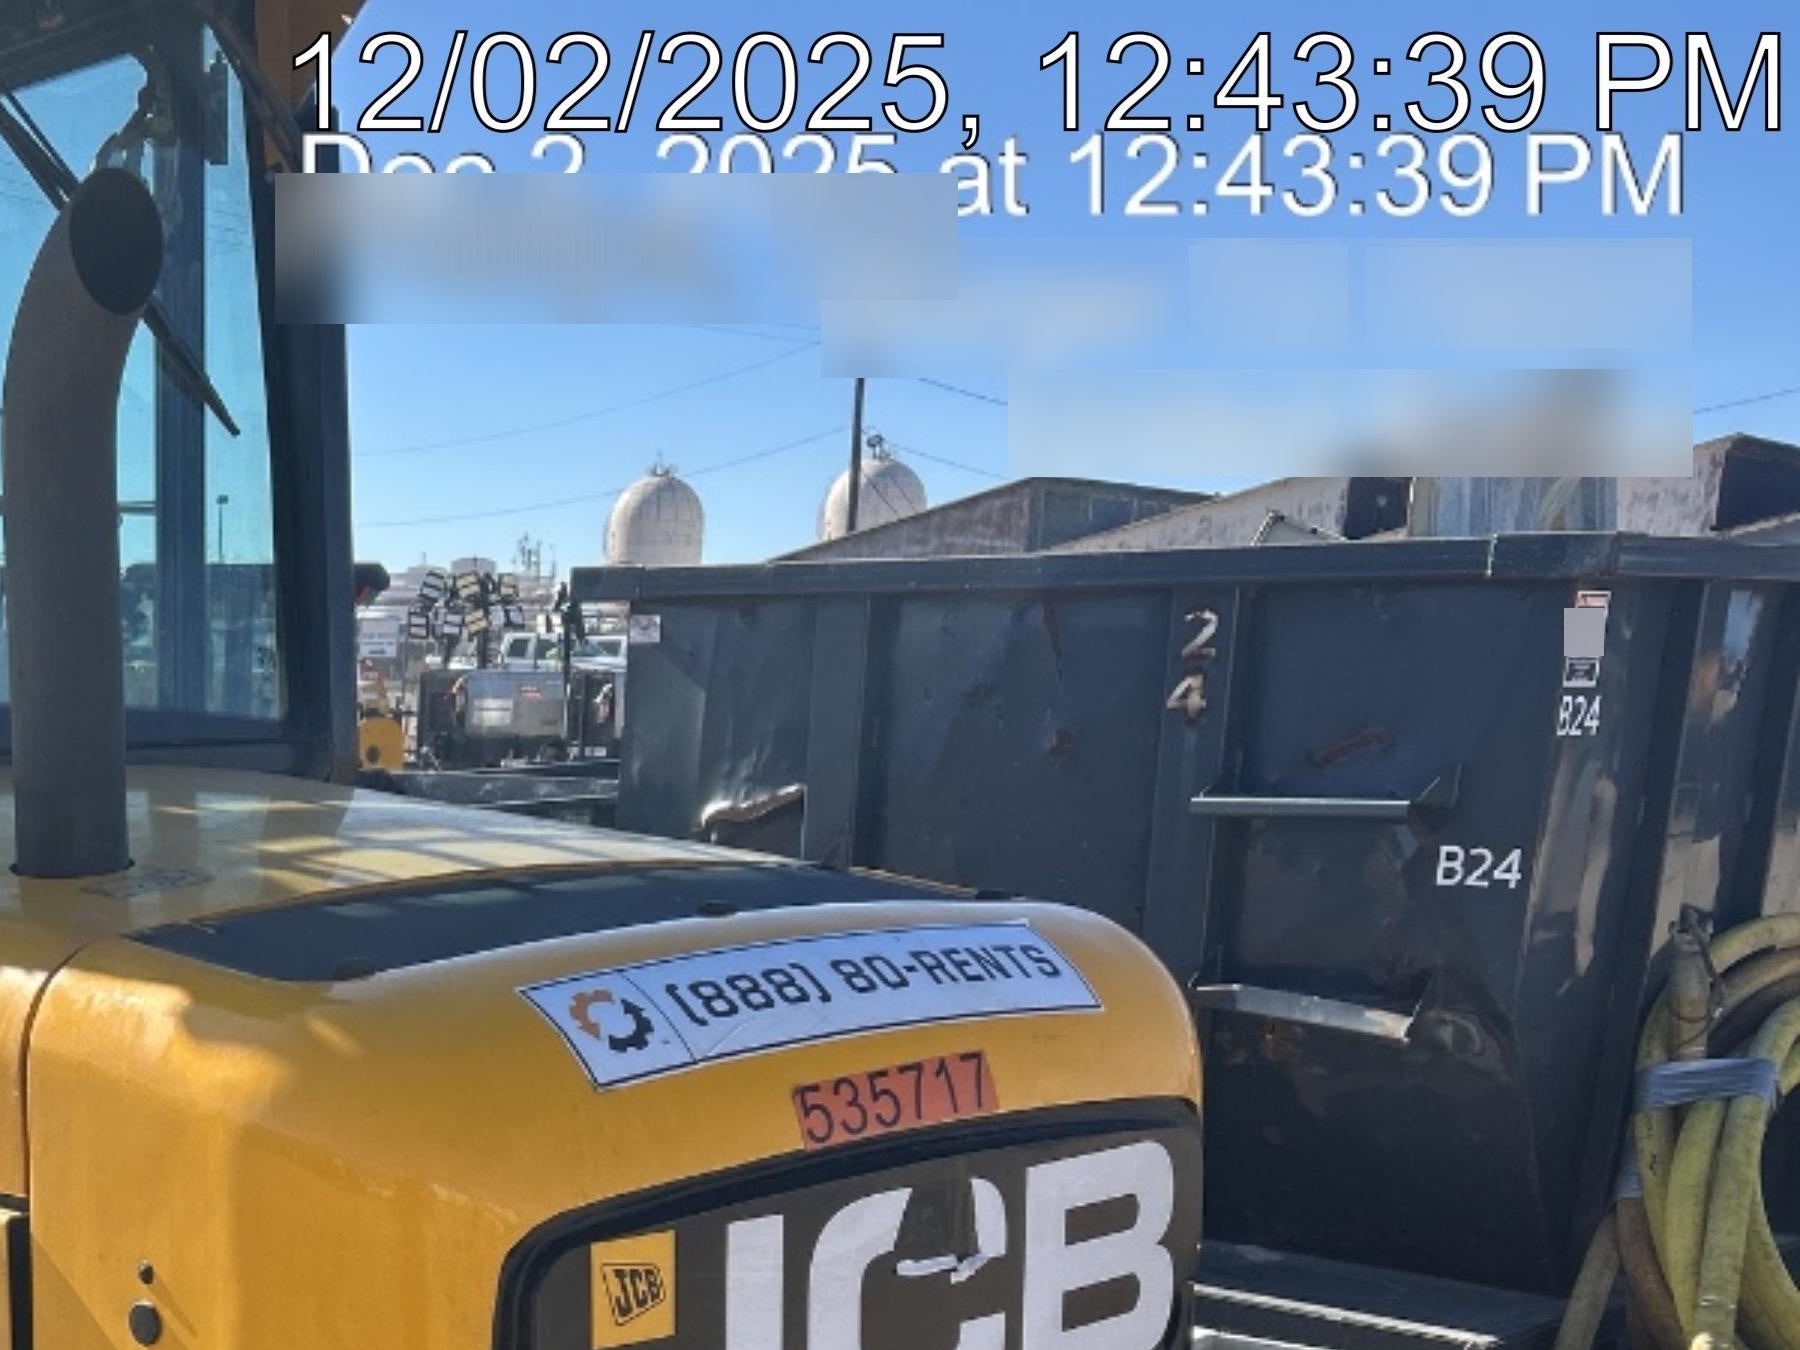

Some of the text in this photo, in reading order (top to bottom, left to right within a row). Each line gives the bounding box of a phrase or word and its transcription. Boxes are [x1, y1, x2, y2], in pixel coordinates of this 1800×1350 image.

[1556, 695, 1602, 736] B24
[1435, 844, 1523, 889] B24
[665, 962, 832, 1027] (888)
[794, 1050, 984, 1145] 535717
[612, 1269, 661, 1318] JCB
